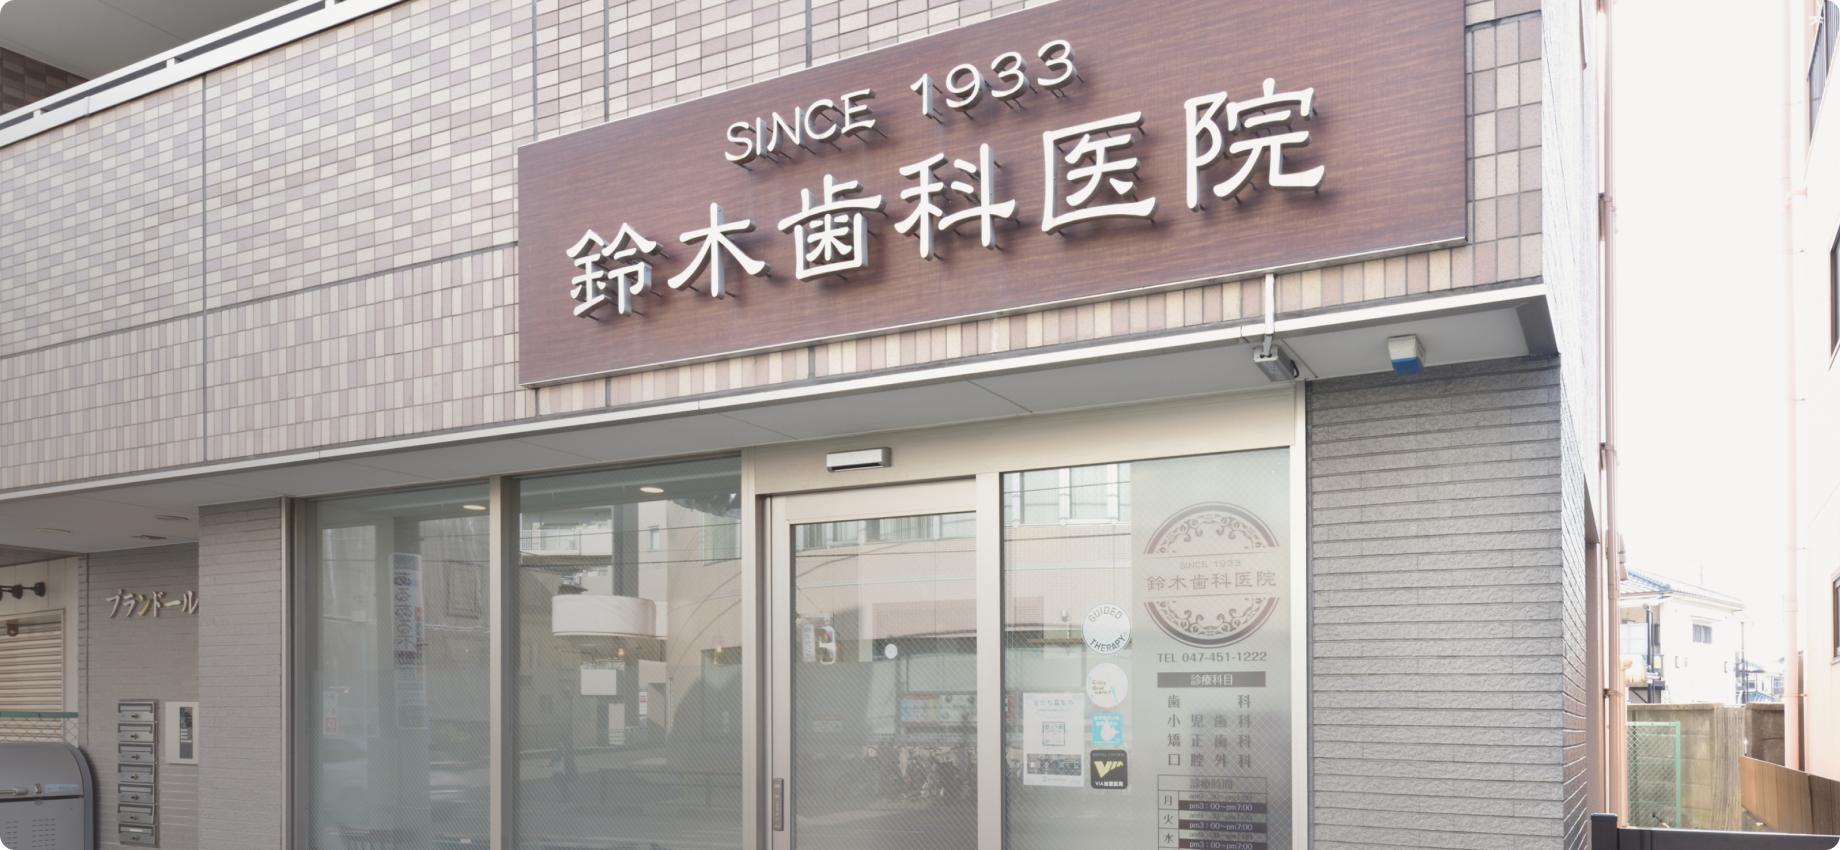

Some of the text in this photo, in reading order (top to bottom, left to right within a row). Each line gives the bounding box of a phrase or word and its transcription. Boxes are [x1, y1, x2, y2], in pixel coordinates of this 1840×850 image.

[725, 39, 1077, 165] SINCE 1933
[566, 78, 1325, 319] 鈴木歯科医院
[1179, 559, 1241, 569] SINCE 1933
[1146, 570, 1277, 592] 鈴木歯科医院
[105, 588, 199, 618] プランドール
[1088, 606, 1123, 623] GUIDED
[1090, 634, 1126, 652] THERAPY
[1157, 651, 1267, 663] TEL 047-451-1222
[1191, 674, 1233, 686] 診療科目
[1167, 714, 1251, 728] 小児歯科
[1167, 733, 1251, 748] 矯正歯科
[1168, 753, 1251, 768] 口腔外科
[1190, 778, 1233, 790] 診療時間
[1164, 795, 1173, 806] 月
[1163, 814, 1174, 825] 火
[1163, 833, 1174, 844] 水
